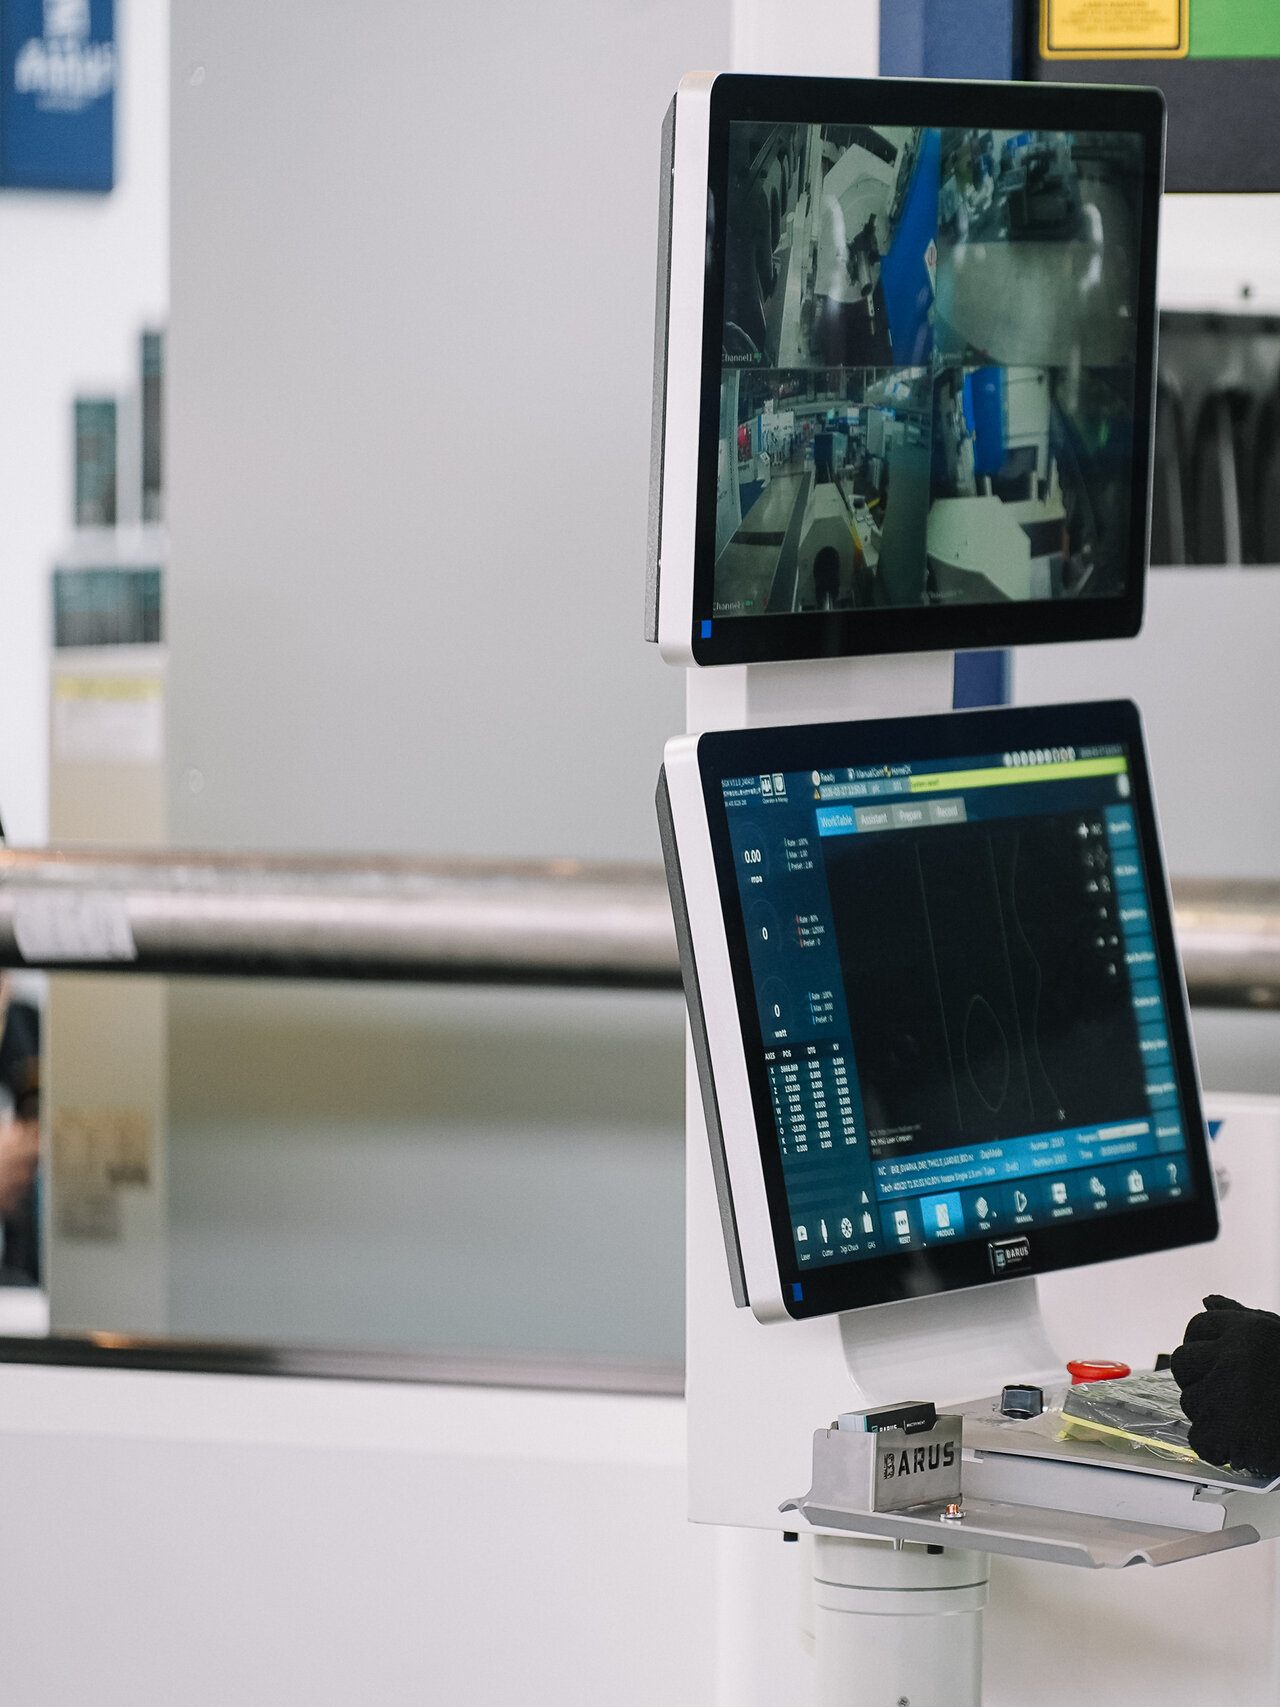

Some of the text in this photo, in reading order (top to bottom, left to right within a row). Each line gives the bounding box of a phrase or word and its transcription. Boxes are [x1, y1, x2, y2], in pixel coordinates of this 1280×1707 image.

[821, 805, 958, 829] WorkTable Assistant Prepare Record
[744, 850, 762, 864] 0.00
[762, 927, 769, 940] 0
[774, 1005, 781, 1018] 0
[775, 1029, 788, 1039] watt
[878, 1167, 887, 1177] NC
[822, 1249, 834, 1258] Cutter
[936, 1228, 955, 1238] PRODUCE
[1006, 1246, 1029, 1258] BARUS
[884, 1441, 954, 1480] BARUS
